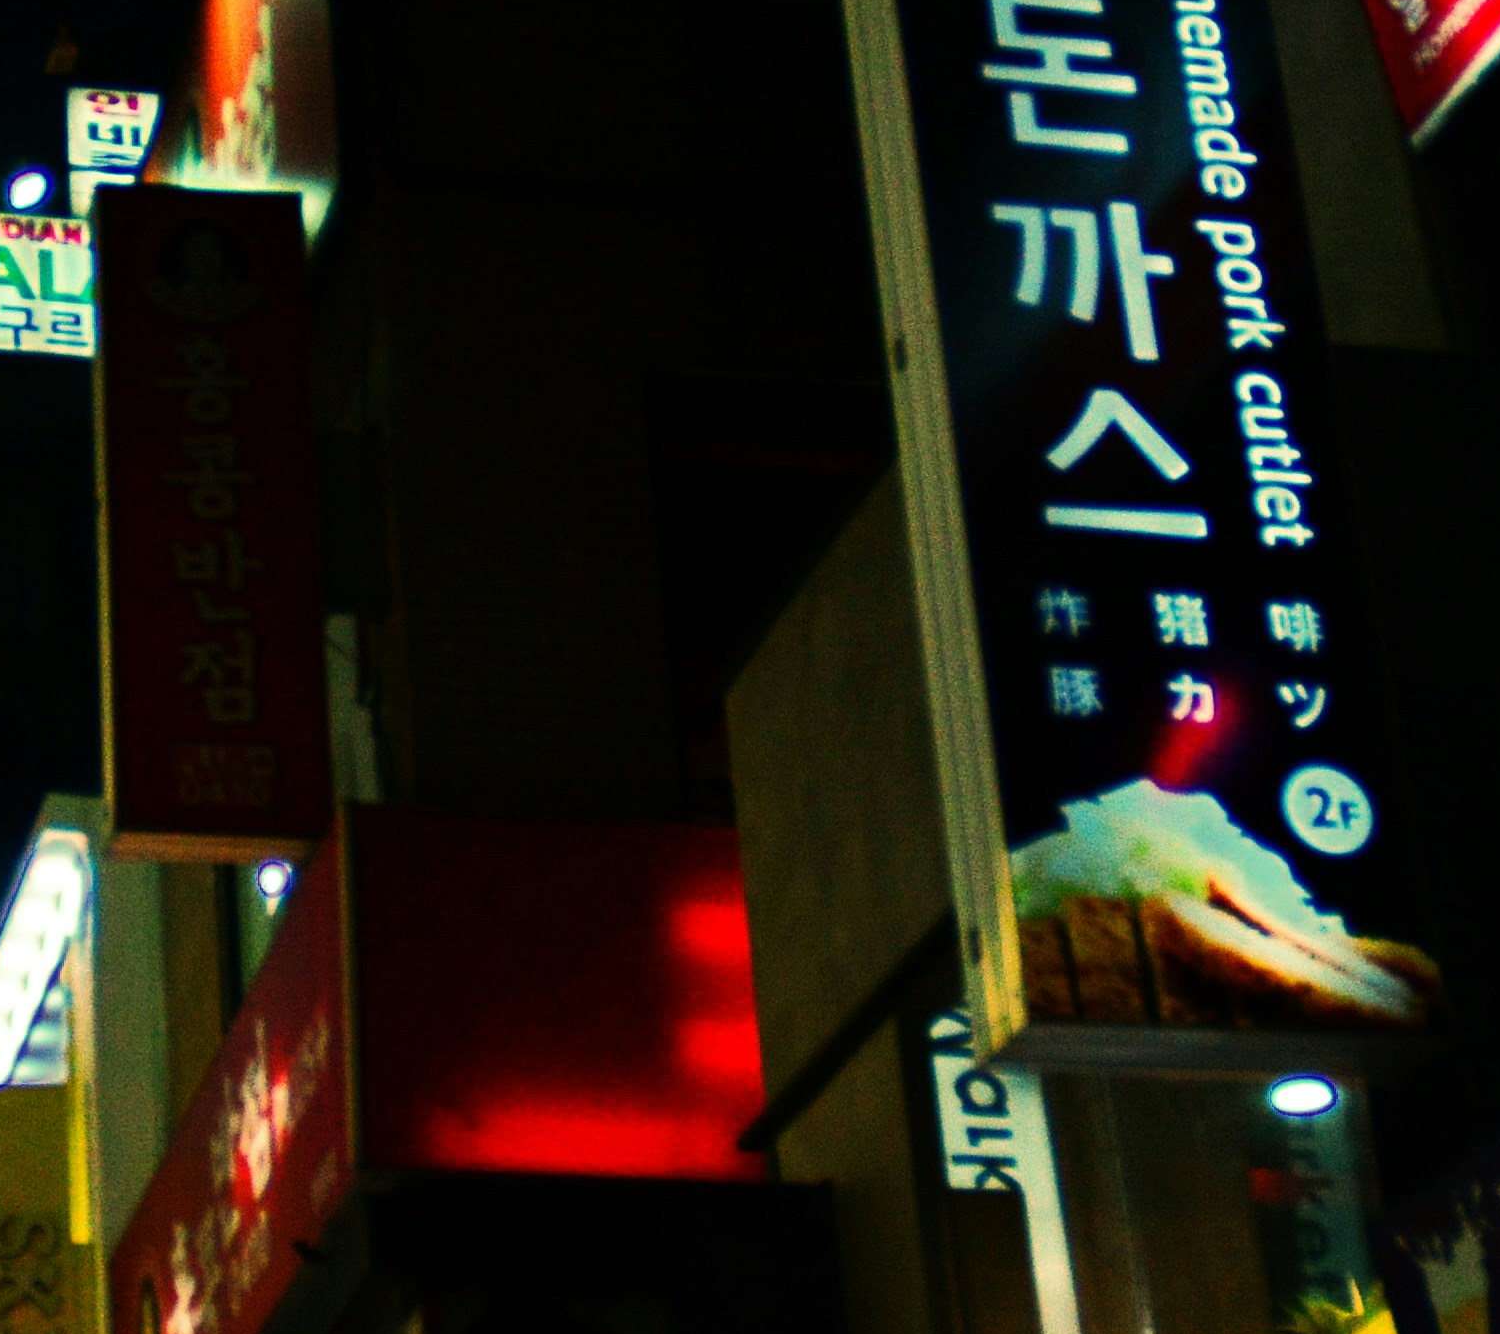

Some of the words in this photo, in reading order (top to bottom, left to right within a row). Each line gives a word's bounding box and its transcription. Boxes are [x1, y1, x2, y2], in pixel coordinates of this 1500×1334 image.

[1194, 214, 1287, 352] pork
[1233, 371, 1315, 548] cutlet
[1305, 786, 1361, 829] 2F
